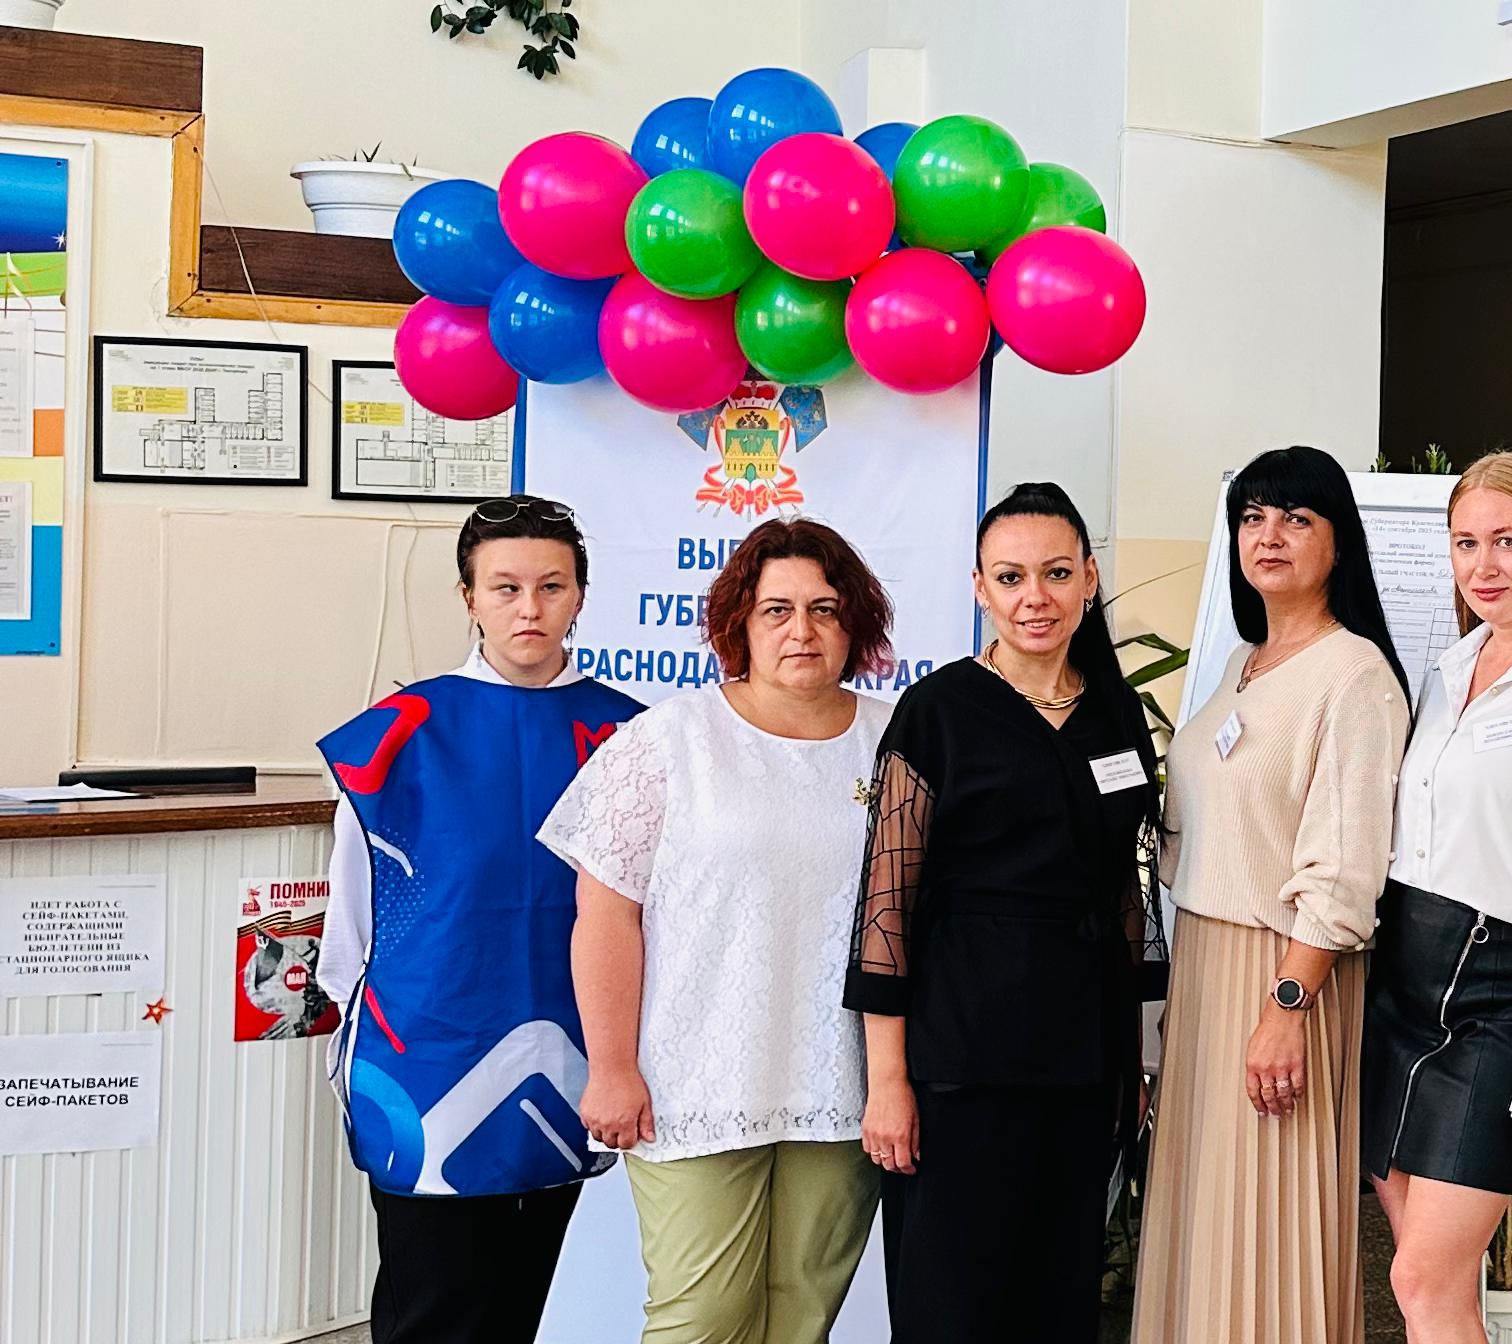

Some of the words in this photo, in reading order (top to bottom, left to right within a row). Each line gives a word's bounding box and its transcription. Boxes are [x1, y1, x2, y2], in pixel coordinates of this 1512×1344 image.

[678, 538, 744, 570] ВЫ
[577, 648, 728, 688] РАСНОДА
[0, 1076, 140, 1090] ЗАПЕЧАТЫВАНИЕ
[4, 1093, 129, 1107] СЕЙФ-ПАКЕТОВ
